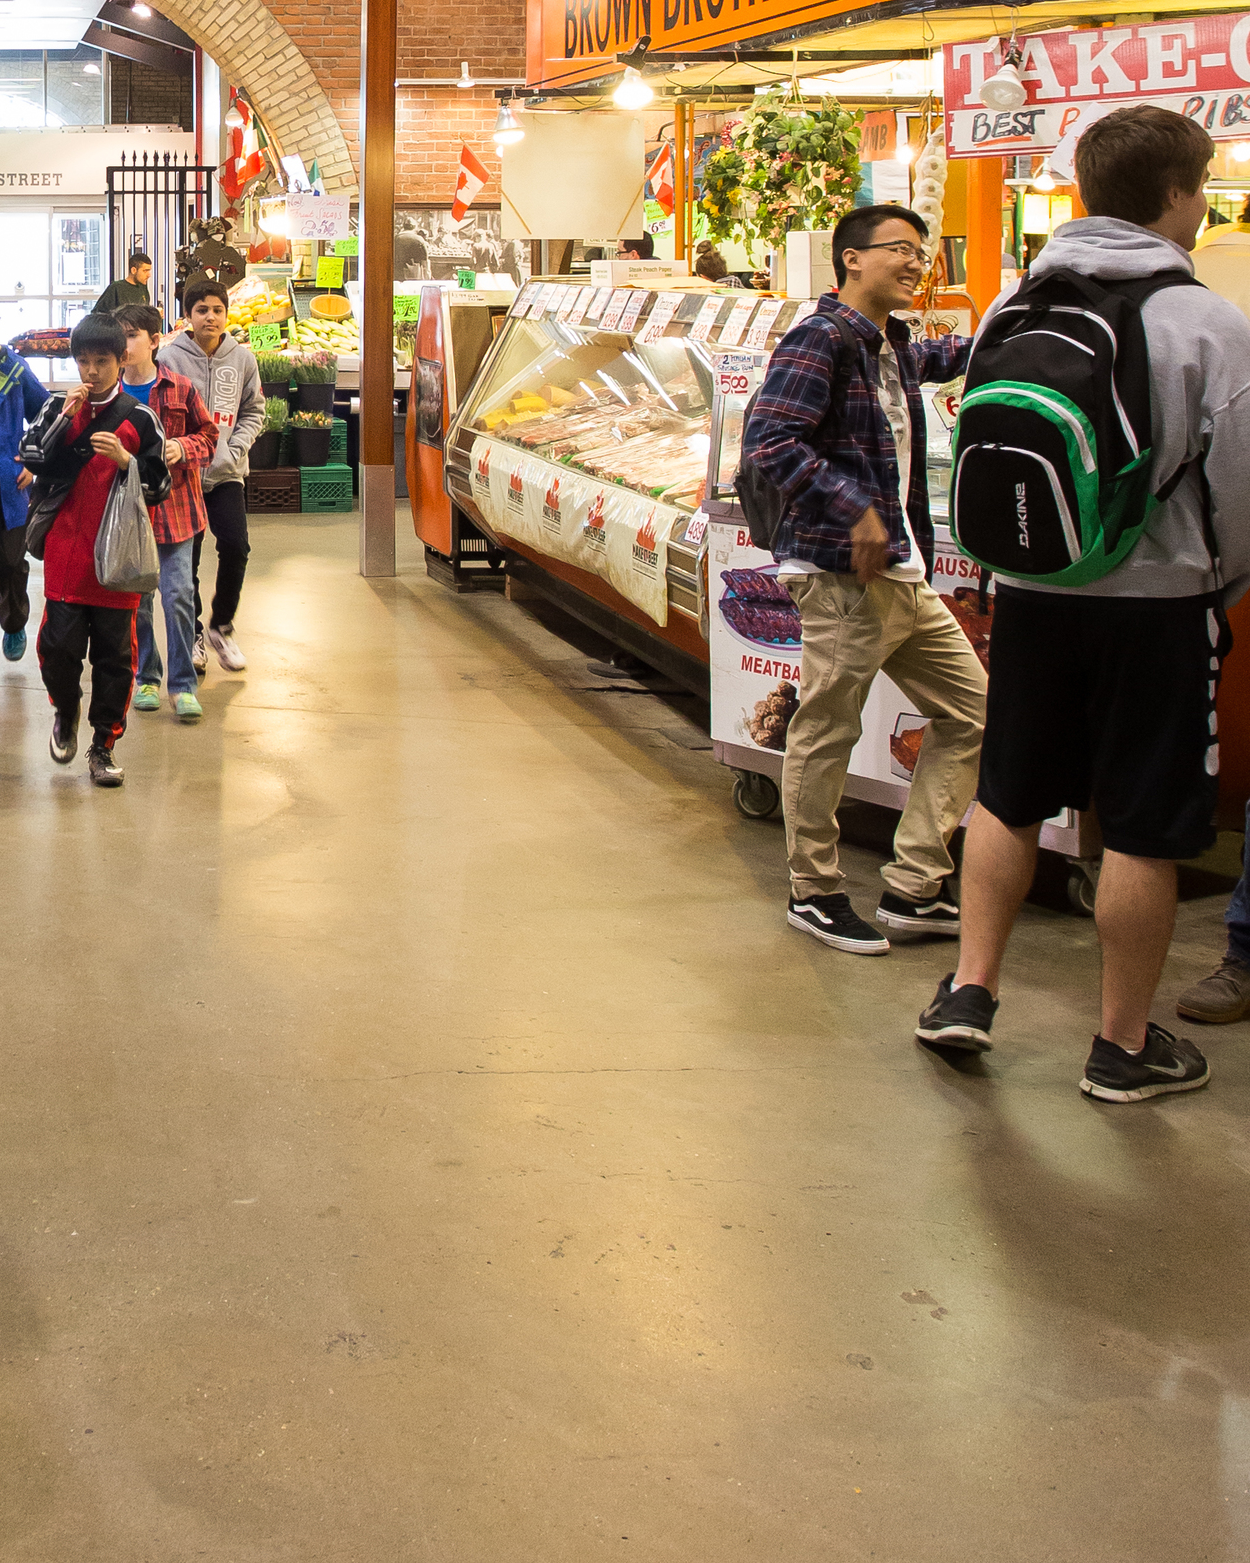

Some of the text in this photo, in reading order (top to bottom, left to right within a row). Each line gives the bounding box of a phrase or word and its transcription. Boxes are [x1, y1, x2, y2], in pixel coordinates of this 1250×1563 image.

[972, 109, 1045, 143] BEST
[215, 366, 238, 414] CDN
[1015, 482, 1029, 549] DAKINE
